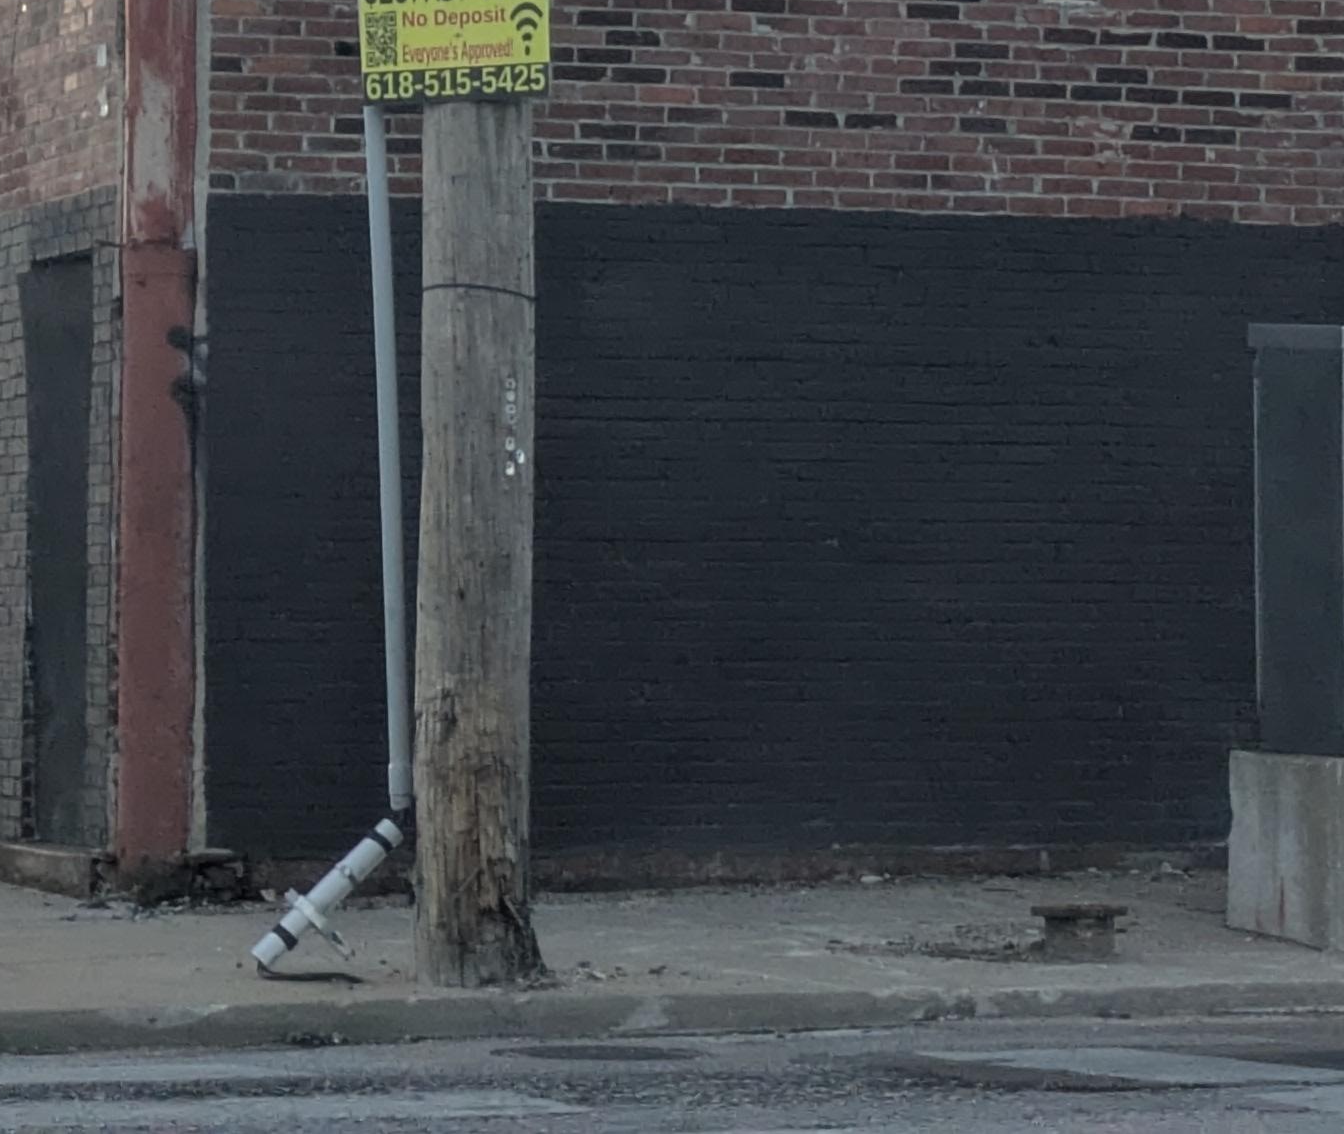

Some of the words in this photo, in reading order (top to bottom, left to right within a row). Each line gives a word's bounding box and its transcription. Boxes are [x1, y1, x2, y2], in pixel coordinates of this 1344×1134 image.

[402, 10, 427, 27] No
[434, 5, 506, 29] Deposit
[402, 41, 458, 66] Everyone's
[461, 38, 513, 63] Approved!
[366, 64, 545, 100] 618-515-5425
